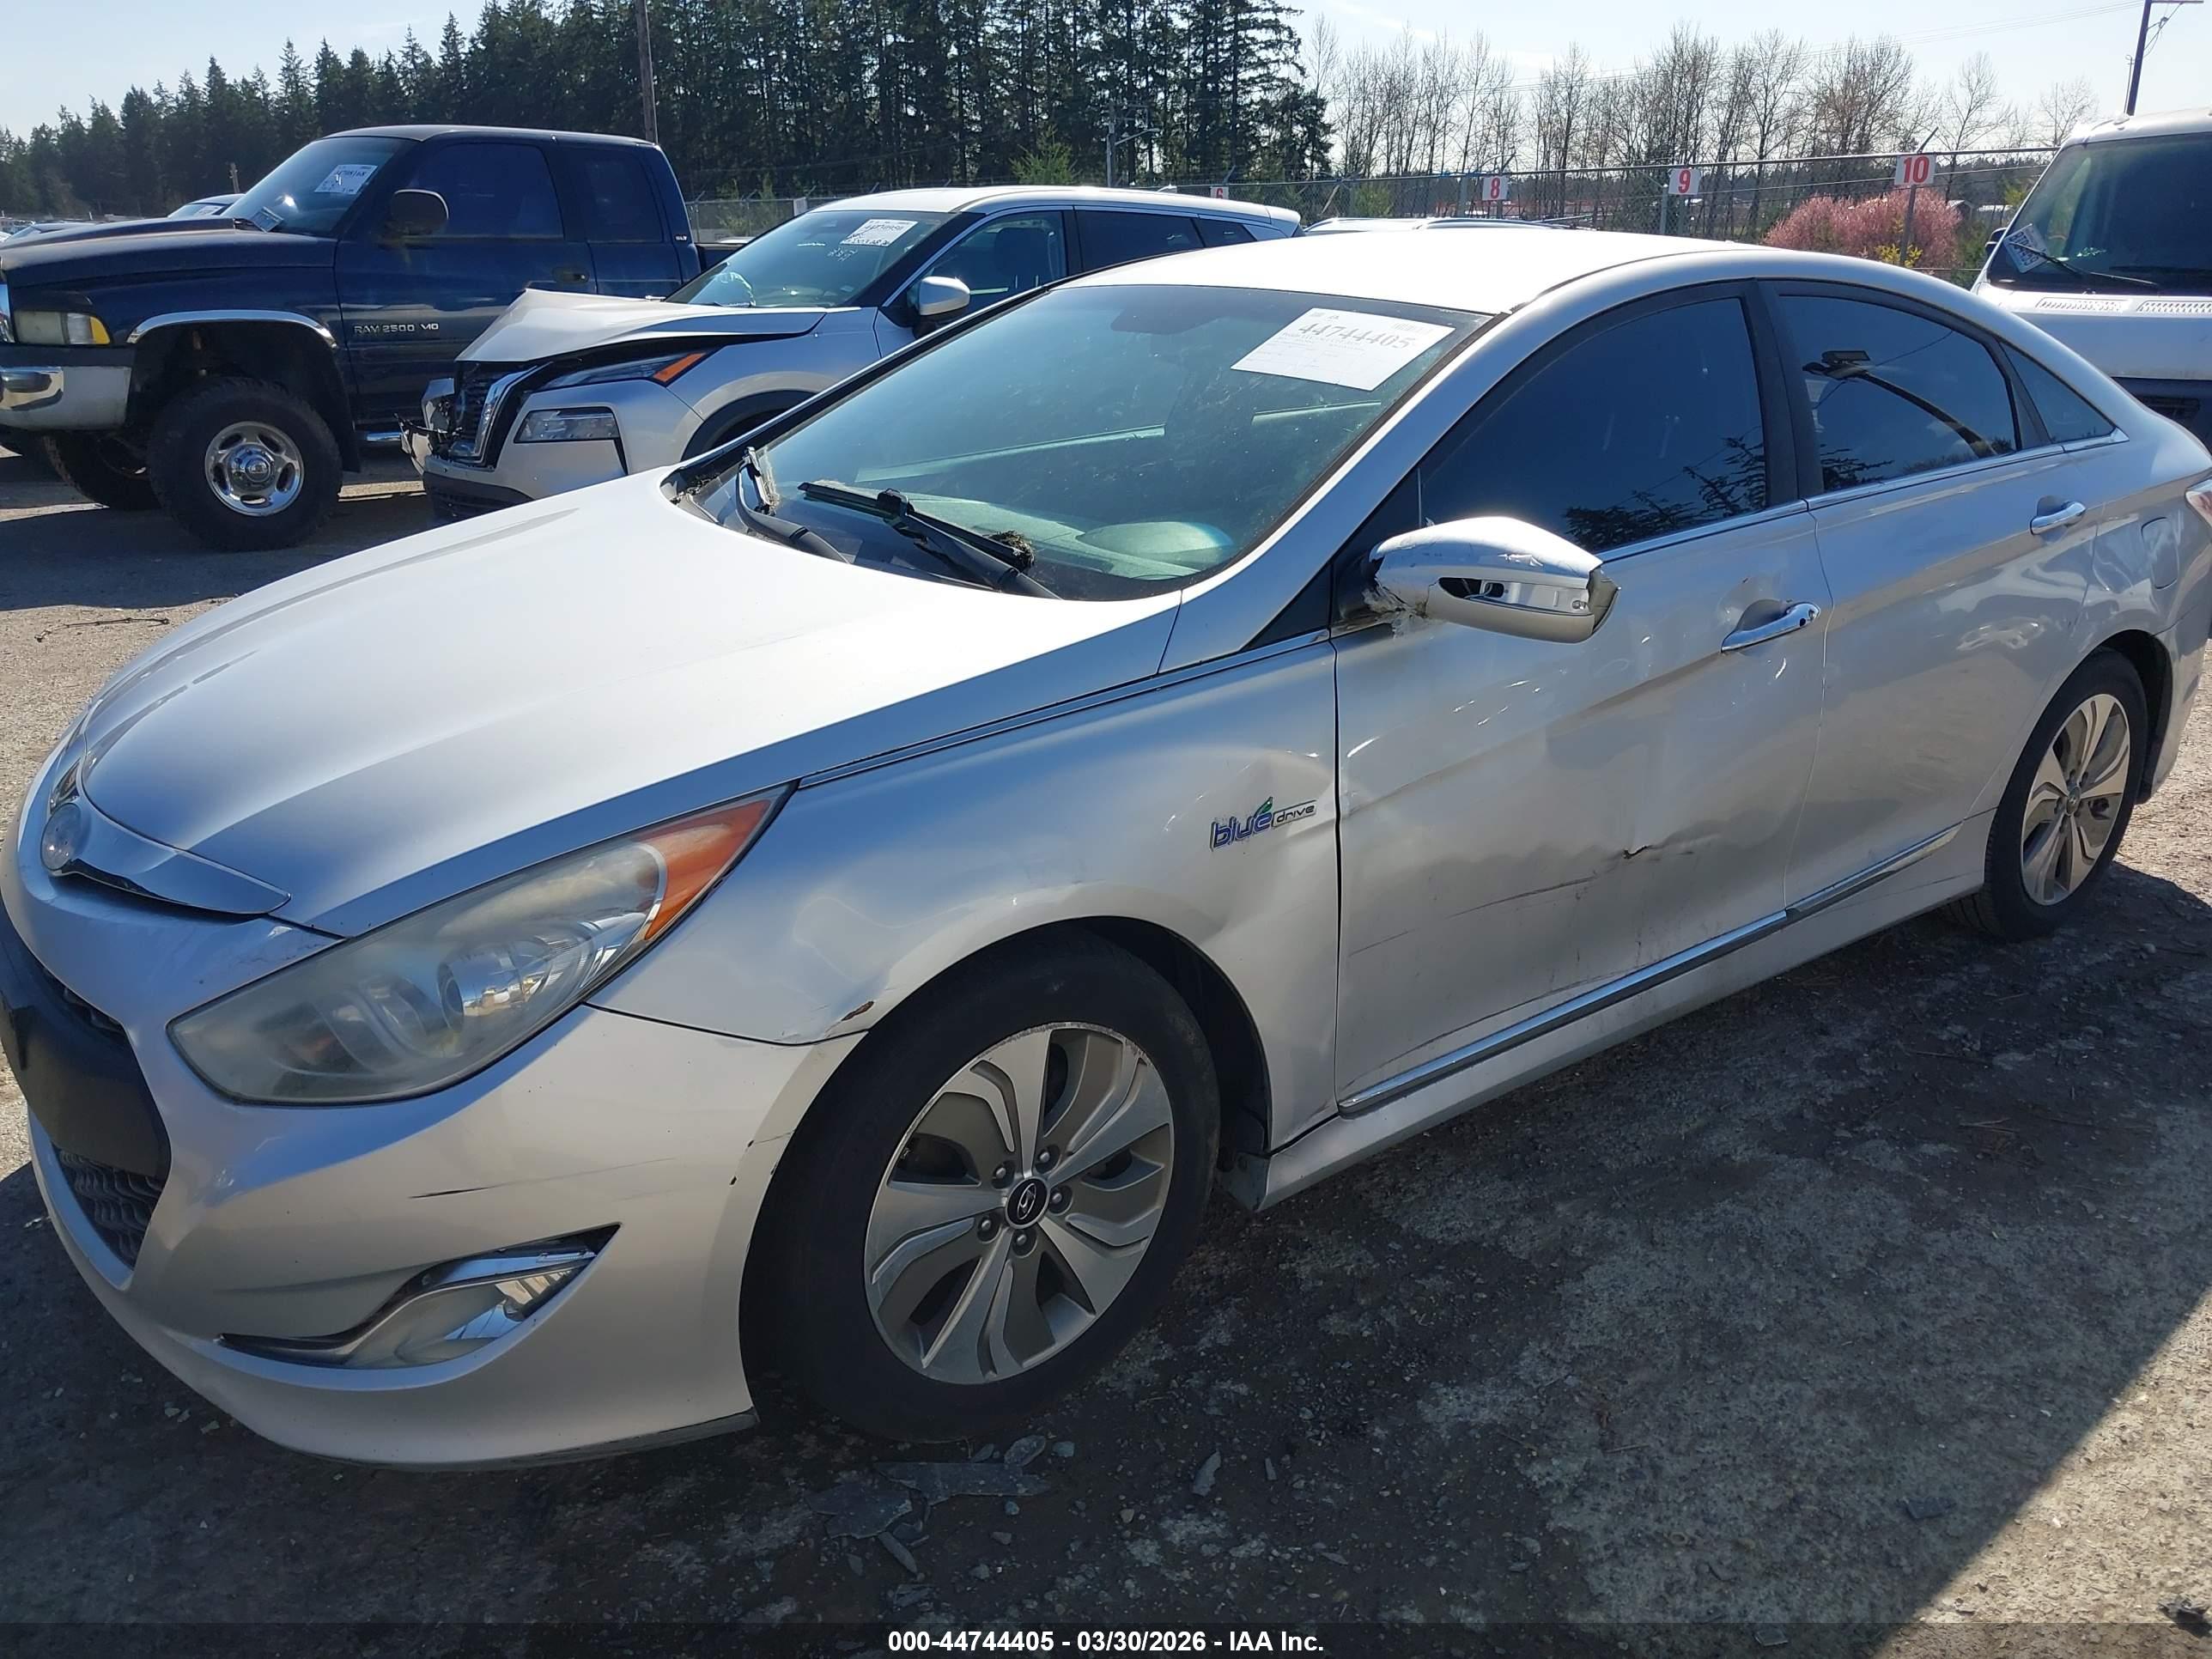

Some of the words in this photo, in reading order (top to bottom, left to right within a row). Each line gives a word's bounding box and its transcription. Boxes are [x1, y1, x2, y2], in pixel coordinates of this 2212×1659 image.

[1678, 170, 1691, 193] 9
[1904, 155, 1929, 183] 10
[1491, 177, 1500, 198] 8
[382, 325, 416, 333] 2500
[1297, 322, 1417, 349] 44744405
[1210, 811, 1273, 851] blue
[1276, 805, 1315, 823] drive
